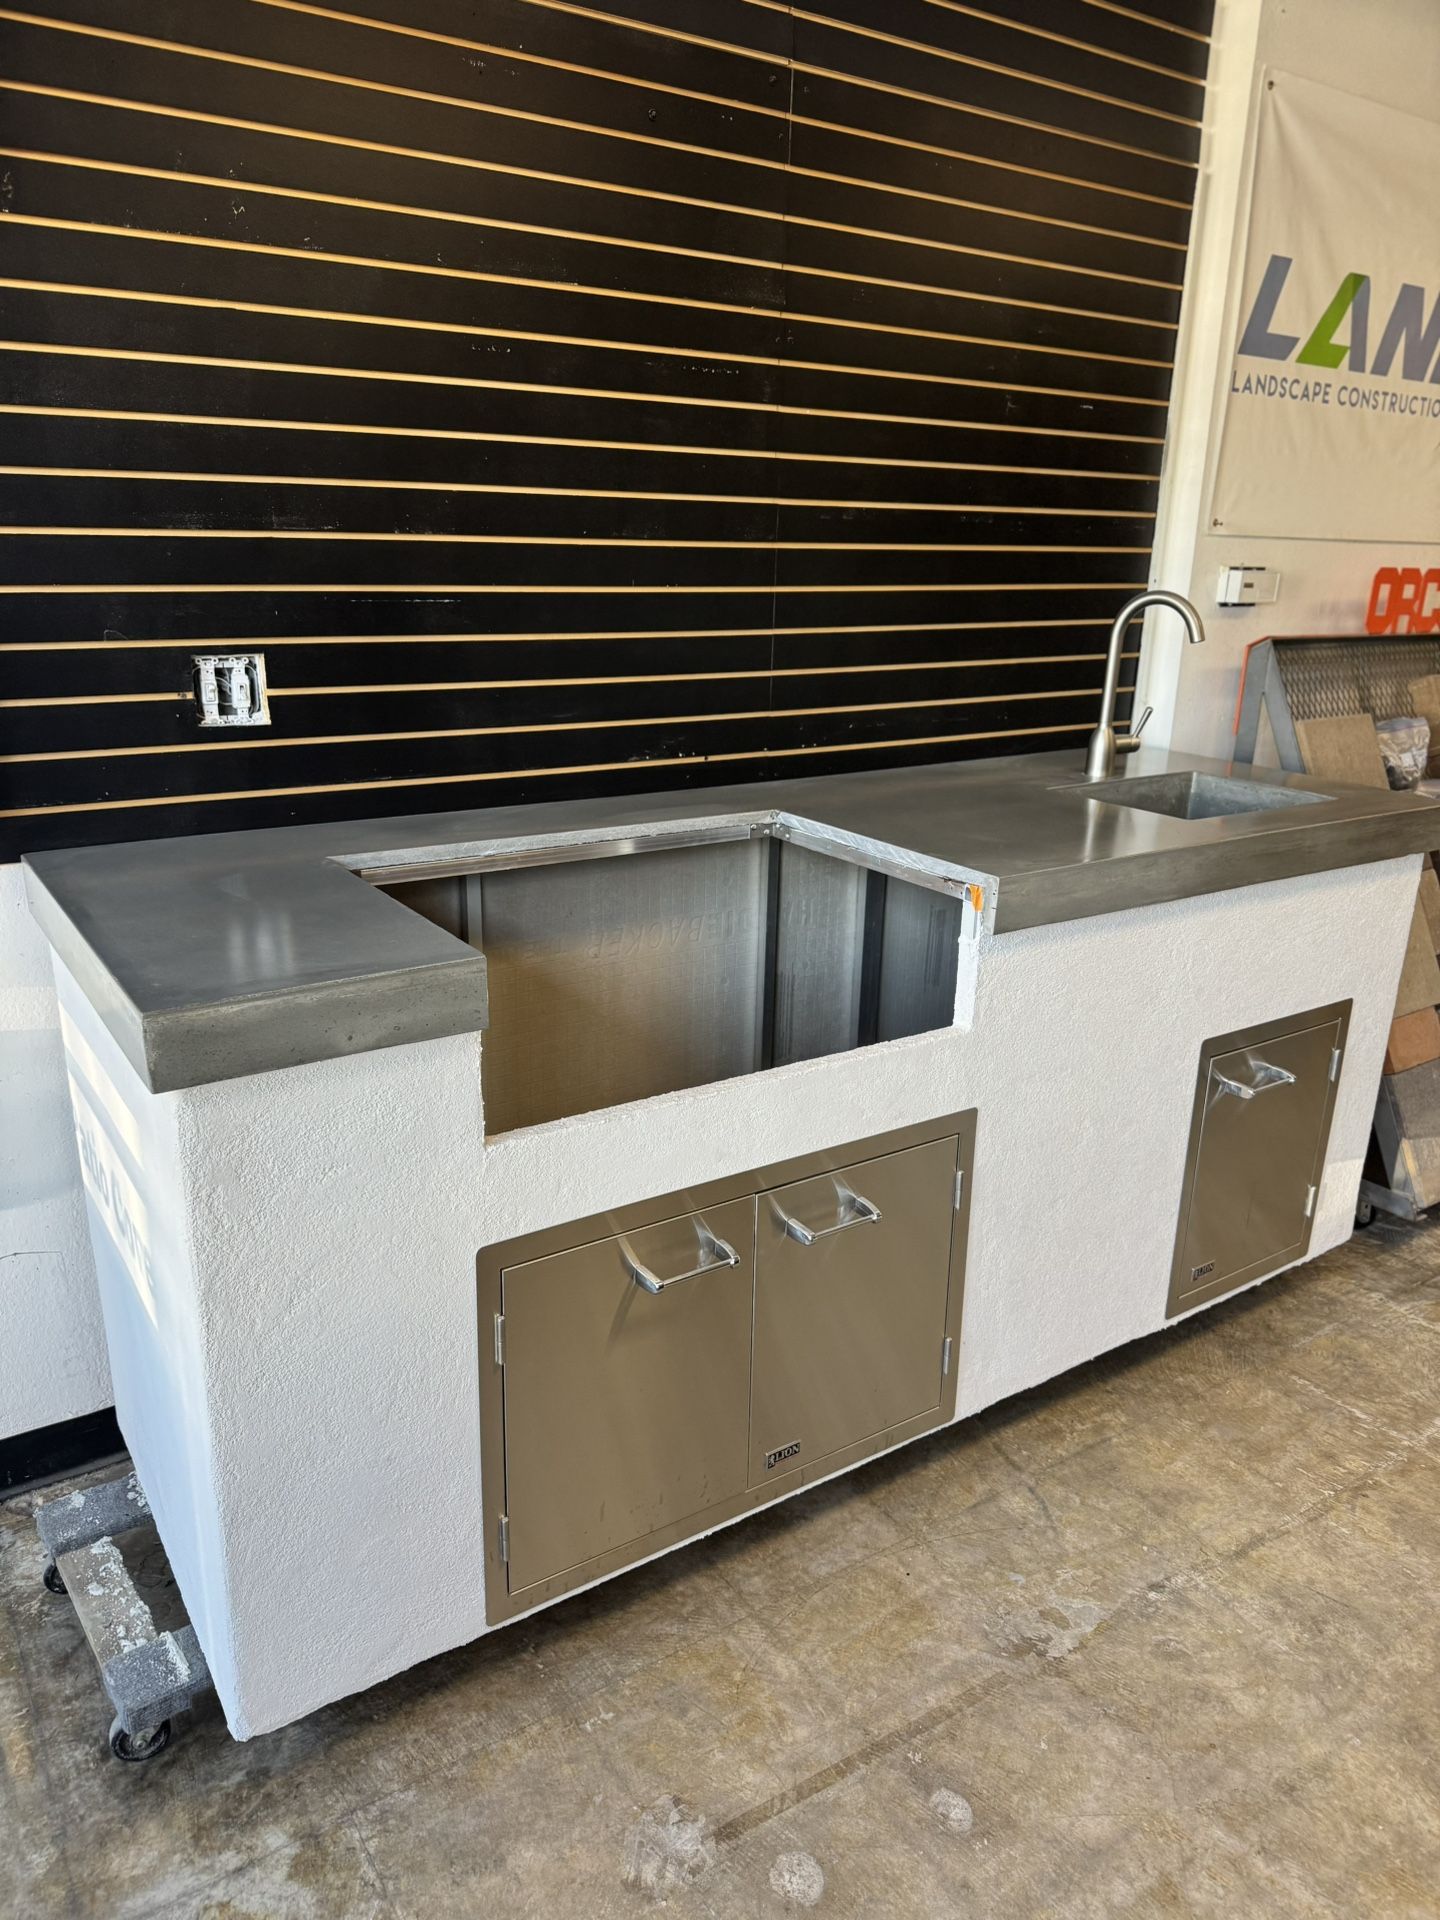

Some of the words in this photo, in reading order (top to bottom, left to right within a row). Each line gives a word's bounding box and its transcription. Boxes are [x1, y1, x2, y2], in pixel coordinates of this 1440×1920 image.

[1237, 254, 1440, 385] LAN
[1231, 370, 1332, 405] LANDSCAPE
[775, 1443, 800, 1462] LION
